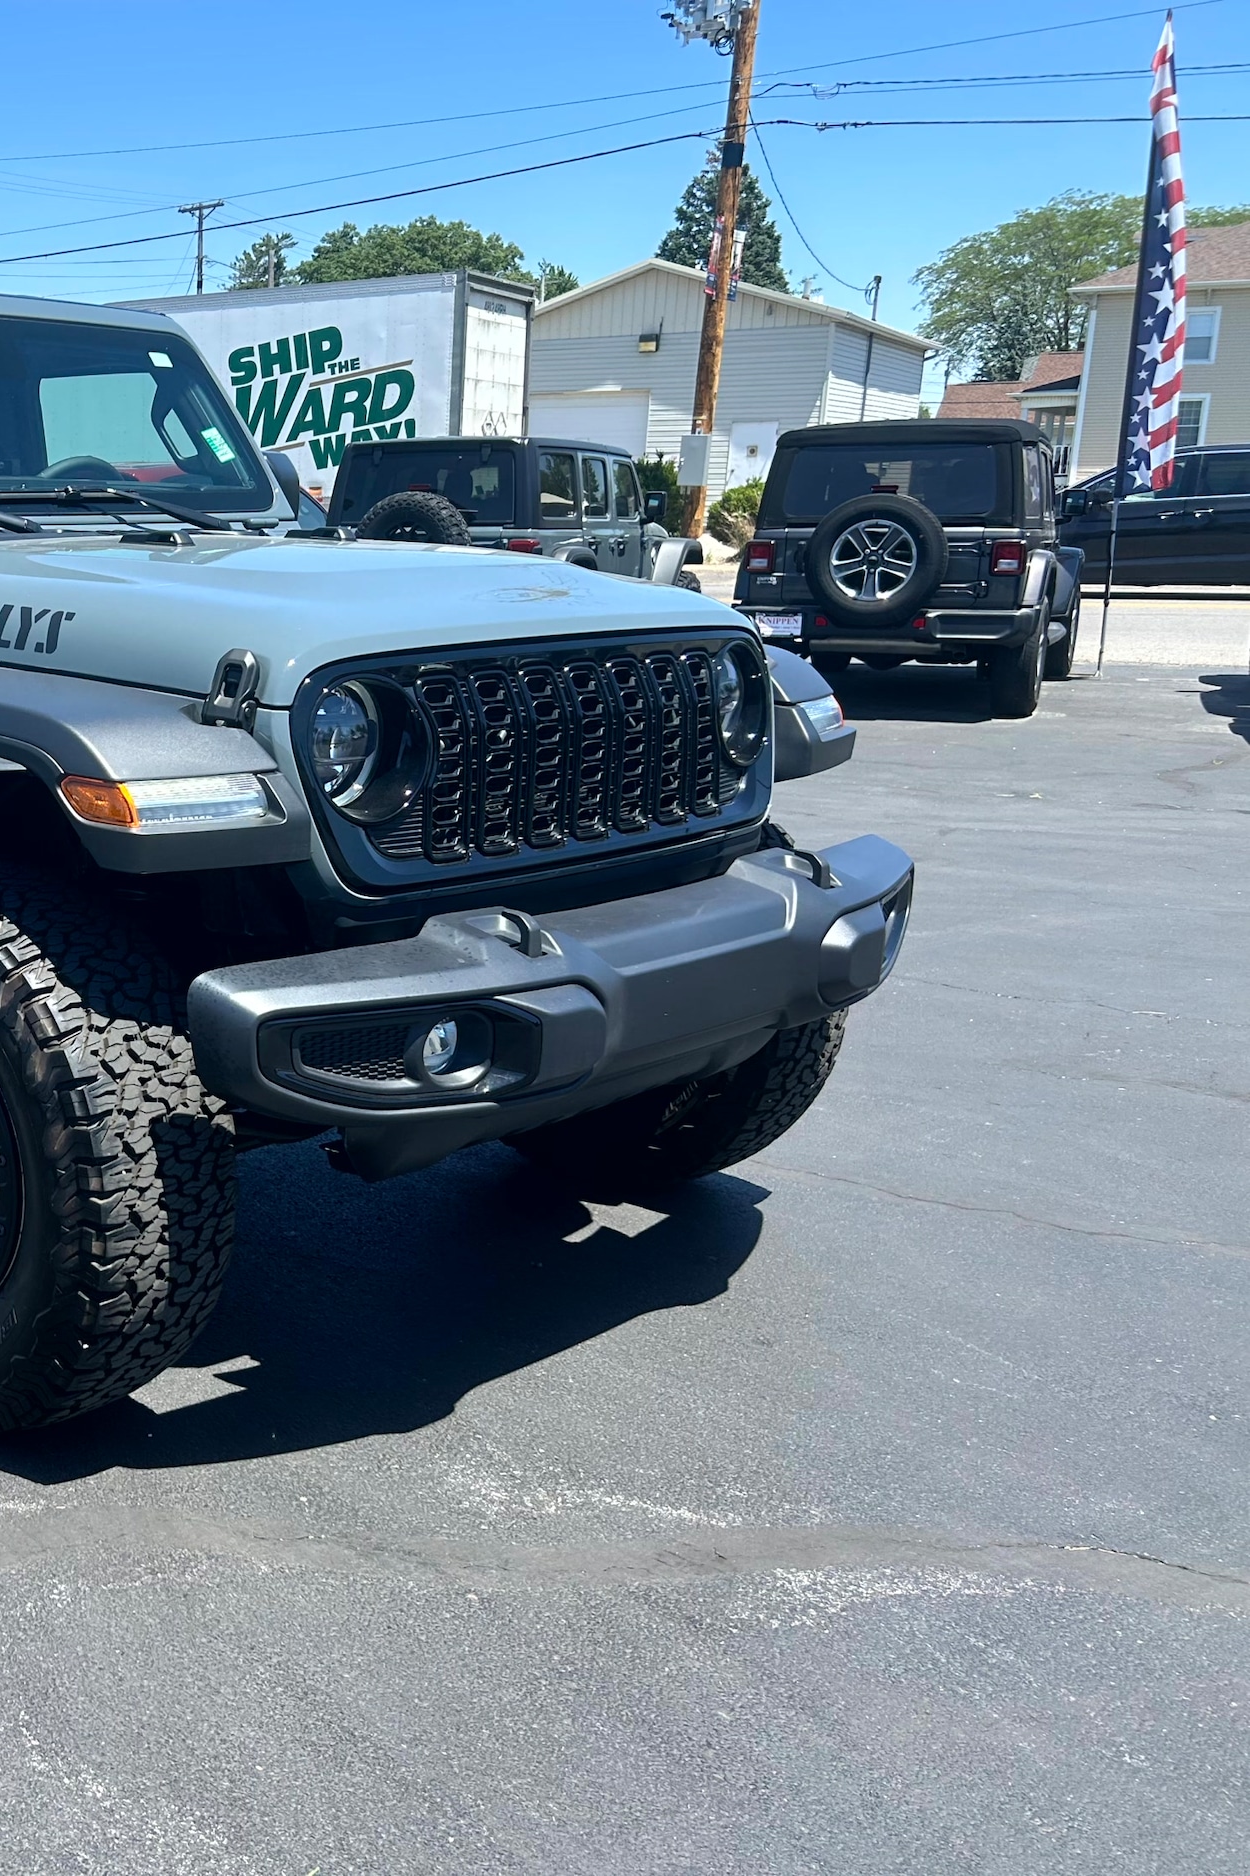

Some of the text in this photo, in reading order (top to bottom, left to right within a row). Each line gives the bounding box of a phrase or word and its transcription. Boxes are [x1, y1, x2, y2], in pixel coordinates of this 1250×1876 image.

[228, 326, 361, 386] SHIP THE
[235, 369, 415, 448] WARD
[758, 616, 798, 625] KNIPPEN
